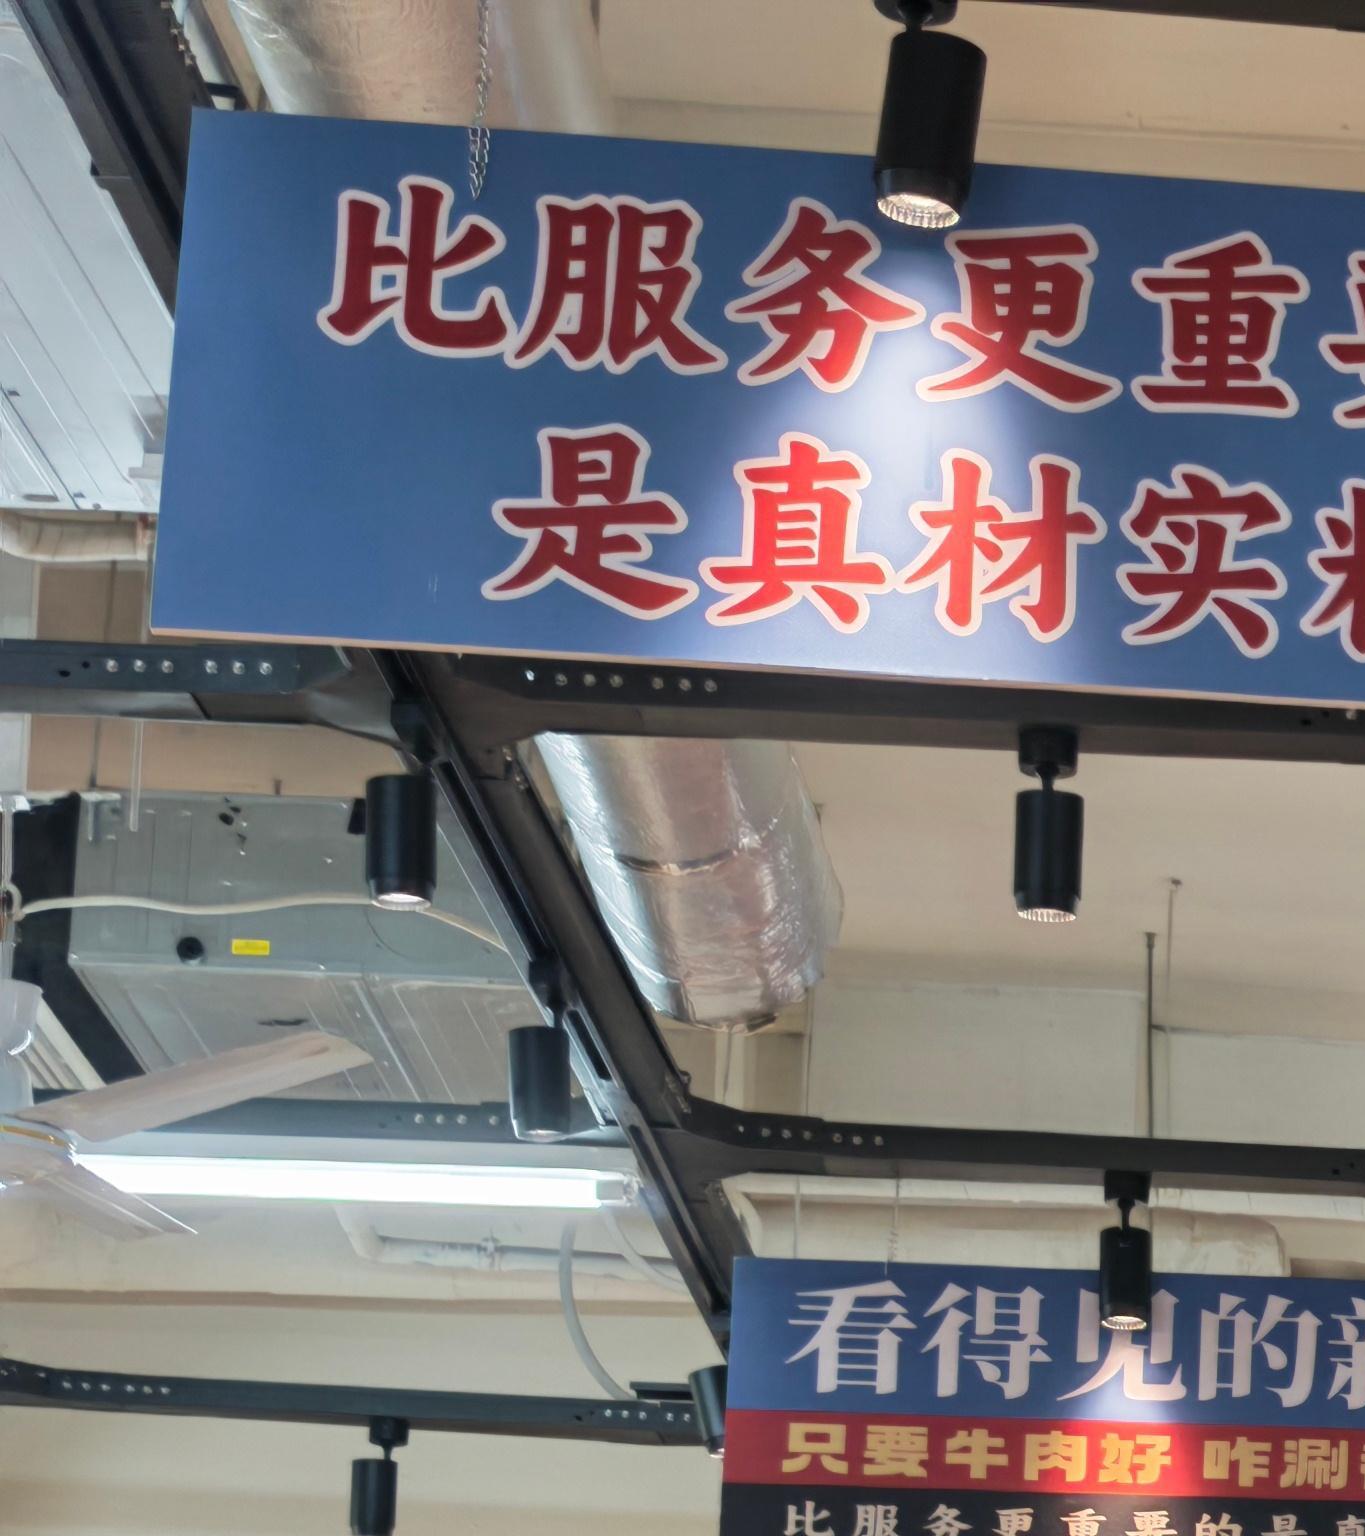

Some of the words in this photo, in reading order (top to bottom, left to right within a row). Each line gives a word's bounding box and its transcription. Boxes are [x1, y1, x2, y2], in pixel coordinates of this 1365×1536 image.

[781, 1422, 1173, 1486] 只要牛肉好
